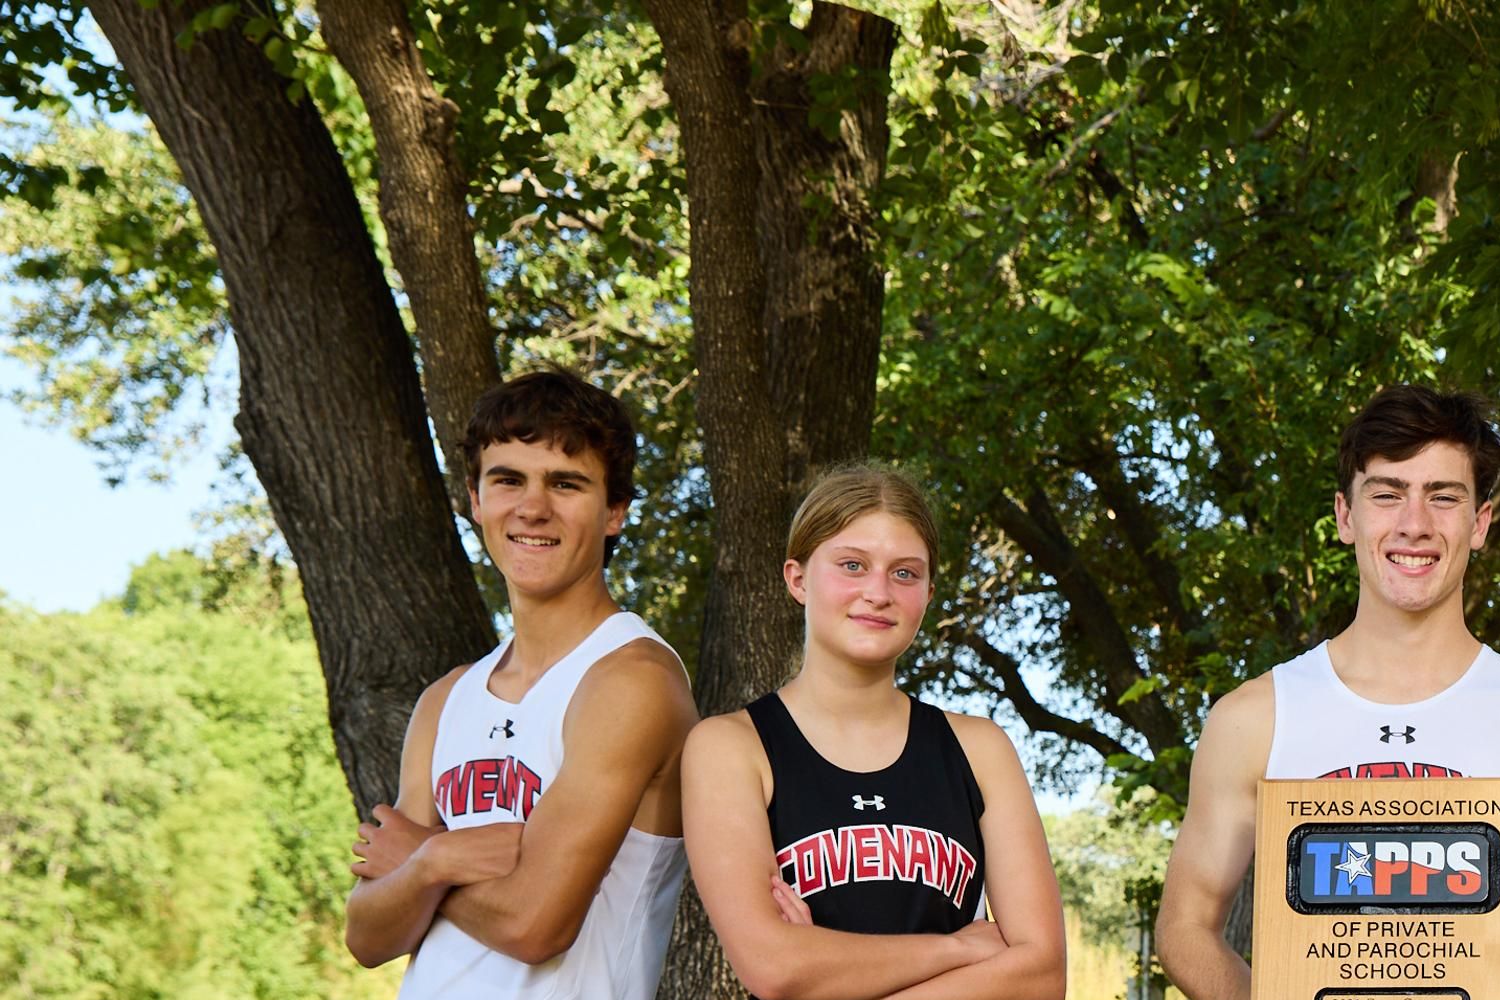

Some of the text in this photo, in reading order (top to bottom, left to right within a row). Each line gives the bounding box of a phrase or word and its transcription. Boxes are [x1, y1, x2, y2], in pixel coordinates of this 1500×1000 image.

[1287, 801, 1353, 816] TEXAS
[1306, 841, 1482, 896] TAPPS
[1333, 922, 1454, 937] OF PRIVATE
[1307, 943, 1480, 958] AND PAROCHIAL
[1340, 963, 1445, 979] SCHOOLS
